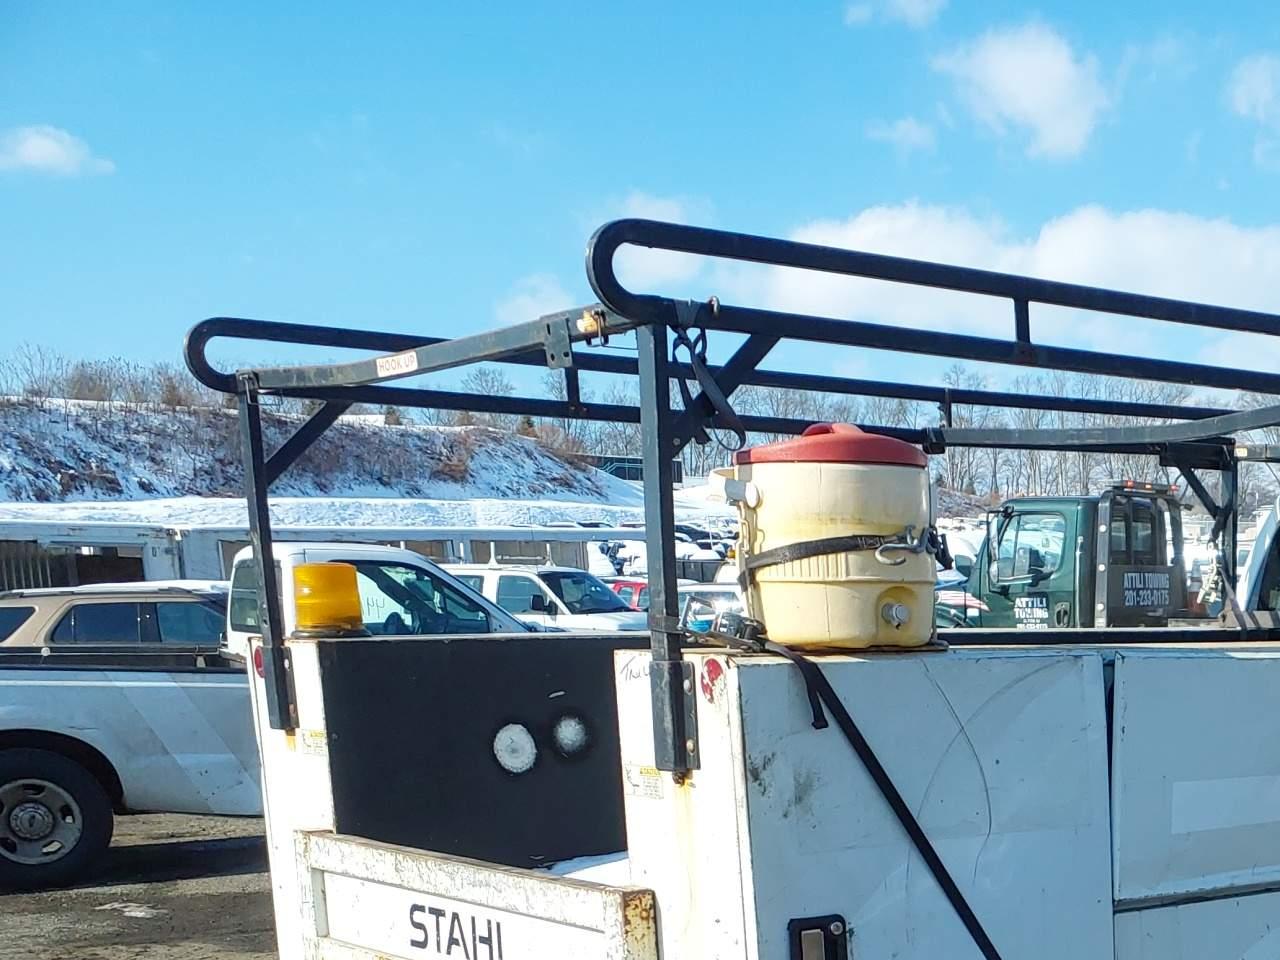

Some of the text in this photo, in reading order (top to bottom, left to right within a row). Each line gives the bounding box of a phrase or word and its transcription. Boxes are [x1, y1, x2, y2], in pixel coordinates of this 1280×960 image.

[378, 354, 415, 372] HOOK UP
[1014, 597, 1047, 608] ATTILI
